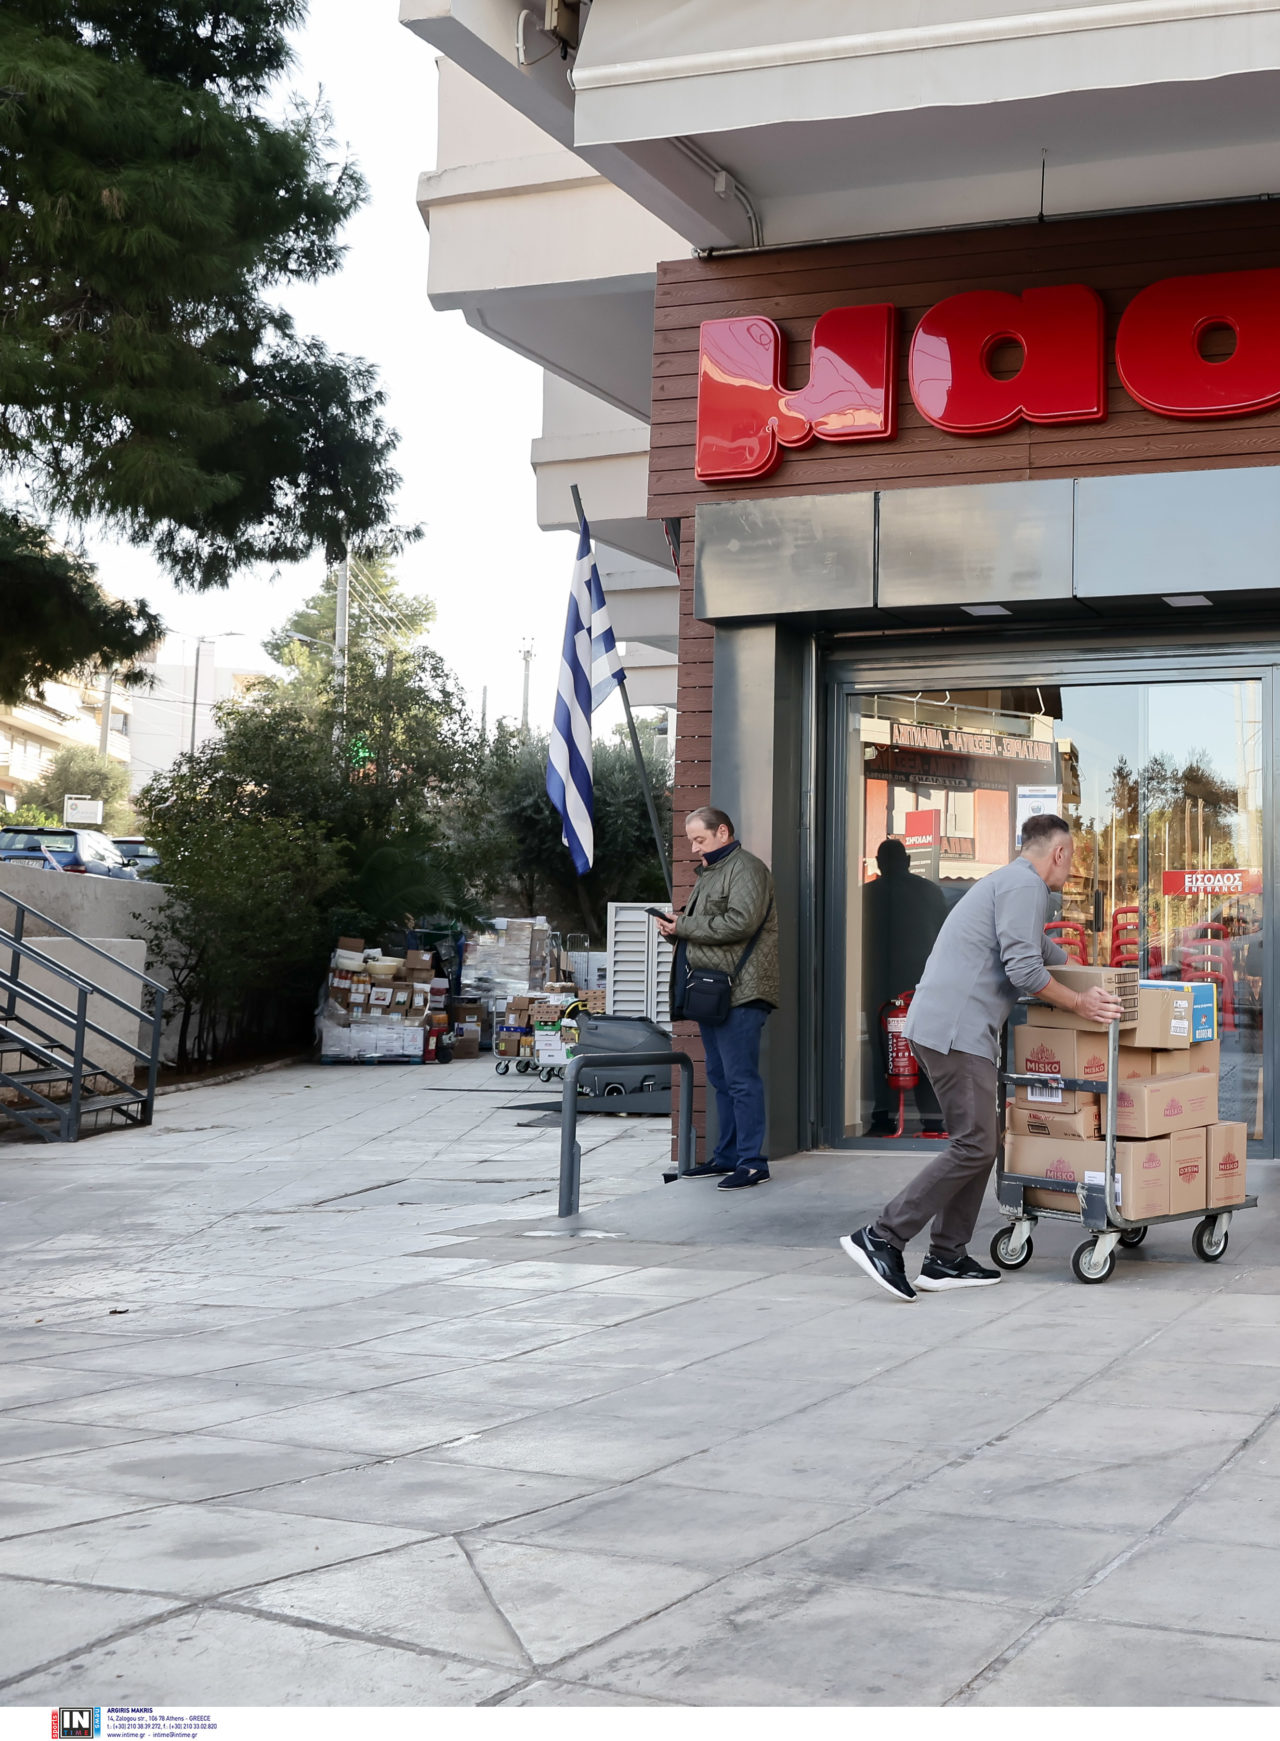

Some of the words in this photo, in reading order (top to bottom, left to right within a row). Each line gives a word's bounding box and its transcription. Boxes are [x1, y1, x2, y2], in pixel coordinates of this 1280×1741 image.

[1184, 873, 1242, 886] ΕΙΣΟΔΟΣ
[1184, 883, 1243, 893] ENTRANCE
[1026, 1061, 1060, 1074] MISKO
[1084, 1064, 1105, 1075] MISKO
[1179, 1165, 1200, 1176] MISKO
[1219, 1160, 1239, 1171] MISKO
[1045, 1169, 1076, 1182] MISKO
